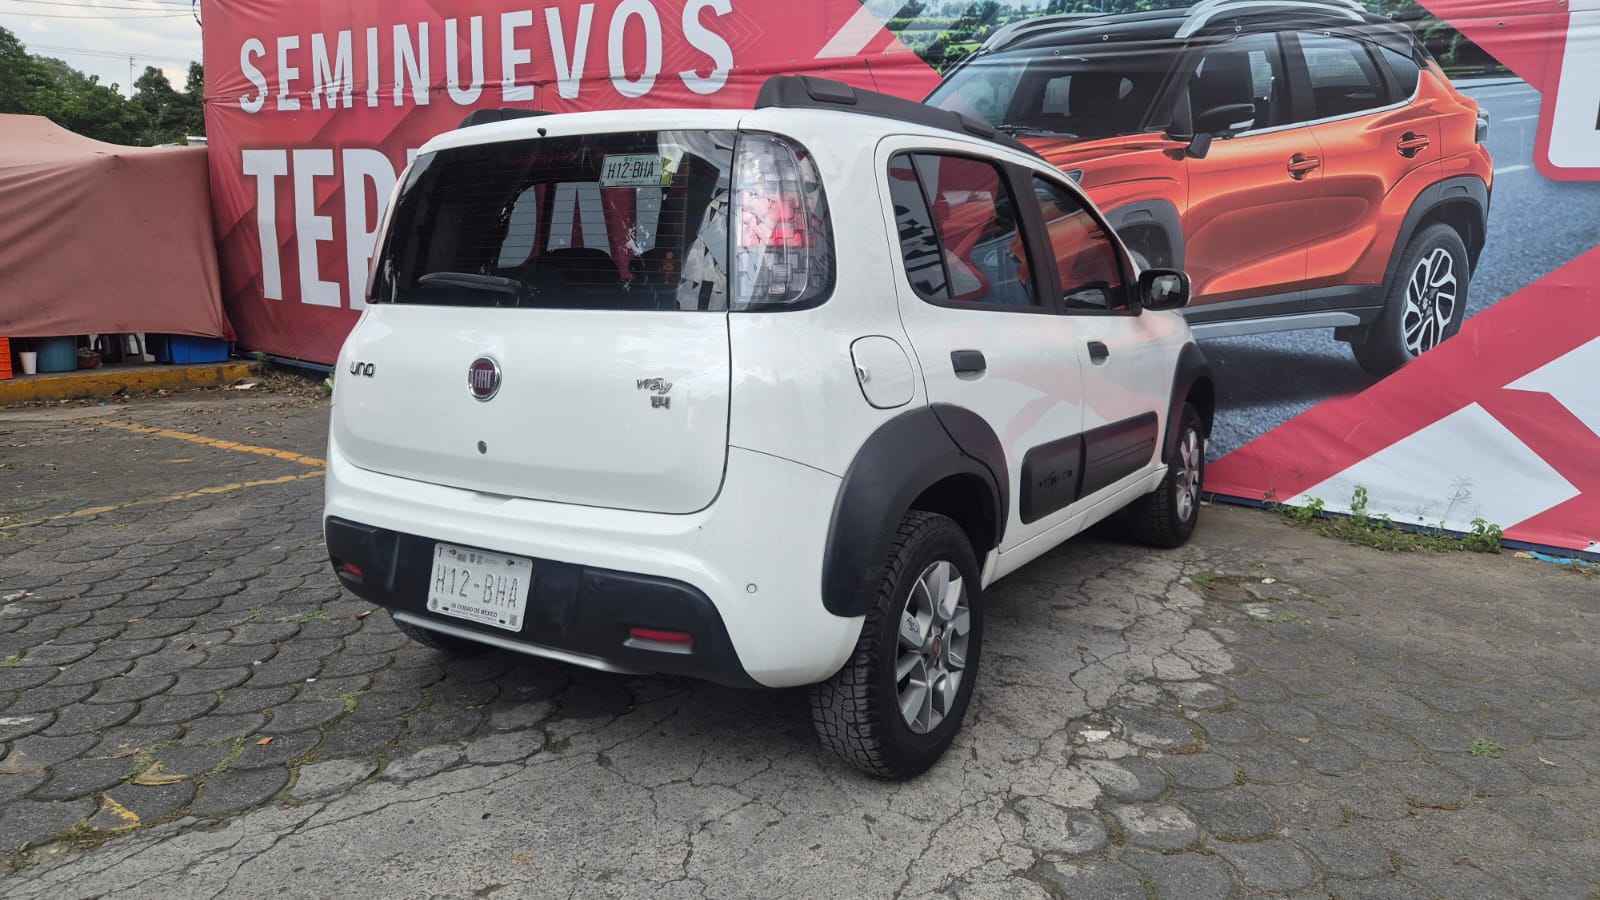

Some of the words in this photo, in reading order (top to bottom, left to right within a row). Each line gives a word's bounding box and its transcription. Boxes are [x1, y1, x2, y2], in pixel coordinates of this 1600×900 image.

[239, 0, 735, 113] SEMINUEVOS
[607, 161, 655, 179] H12-BHA
[474, 369, 493, 388] FIAT
[435, 564, 518, 608] H12-BHA
